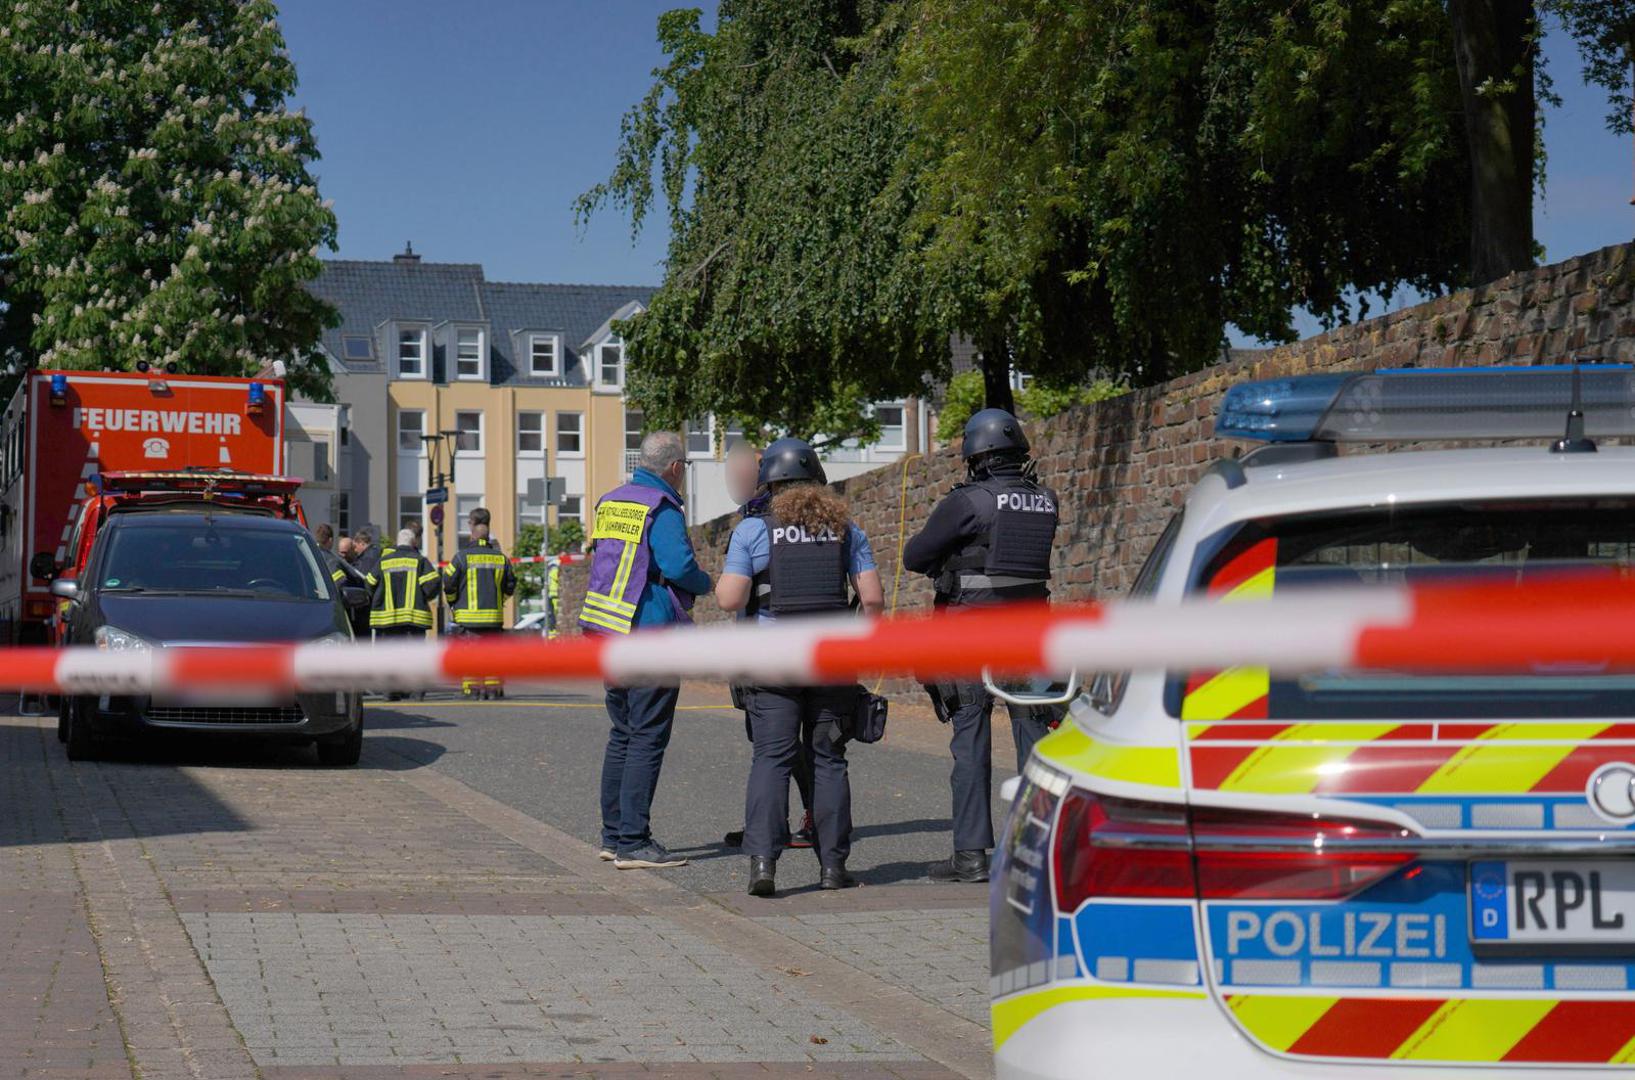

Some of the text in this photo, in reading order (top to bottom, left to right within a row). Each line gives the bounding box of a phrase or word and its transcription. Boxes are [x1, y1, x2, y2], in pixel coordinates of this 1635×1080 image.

[73, 408, 241, 435] FEUERWEHR
[1482, 908, 1498, 927] D
[1514, 871, 1624, 930] RPL
[1228, 911, 1447, 957] POLIZEI
